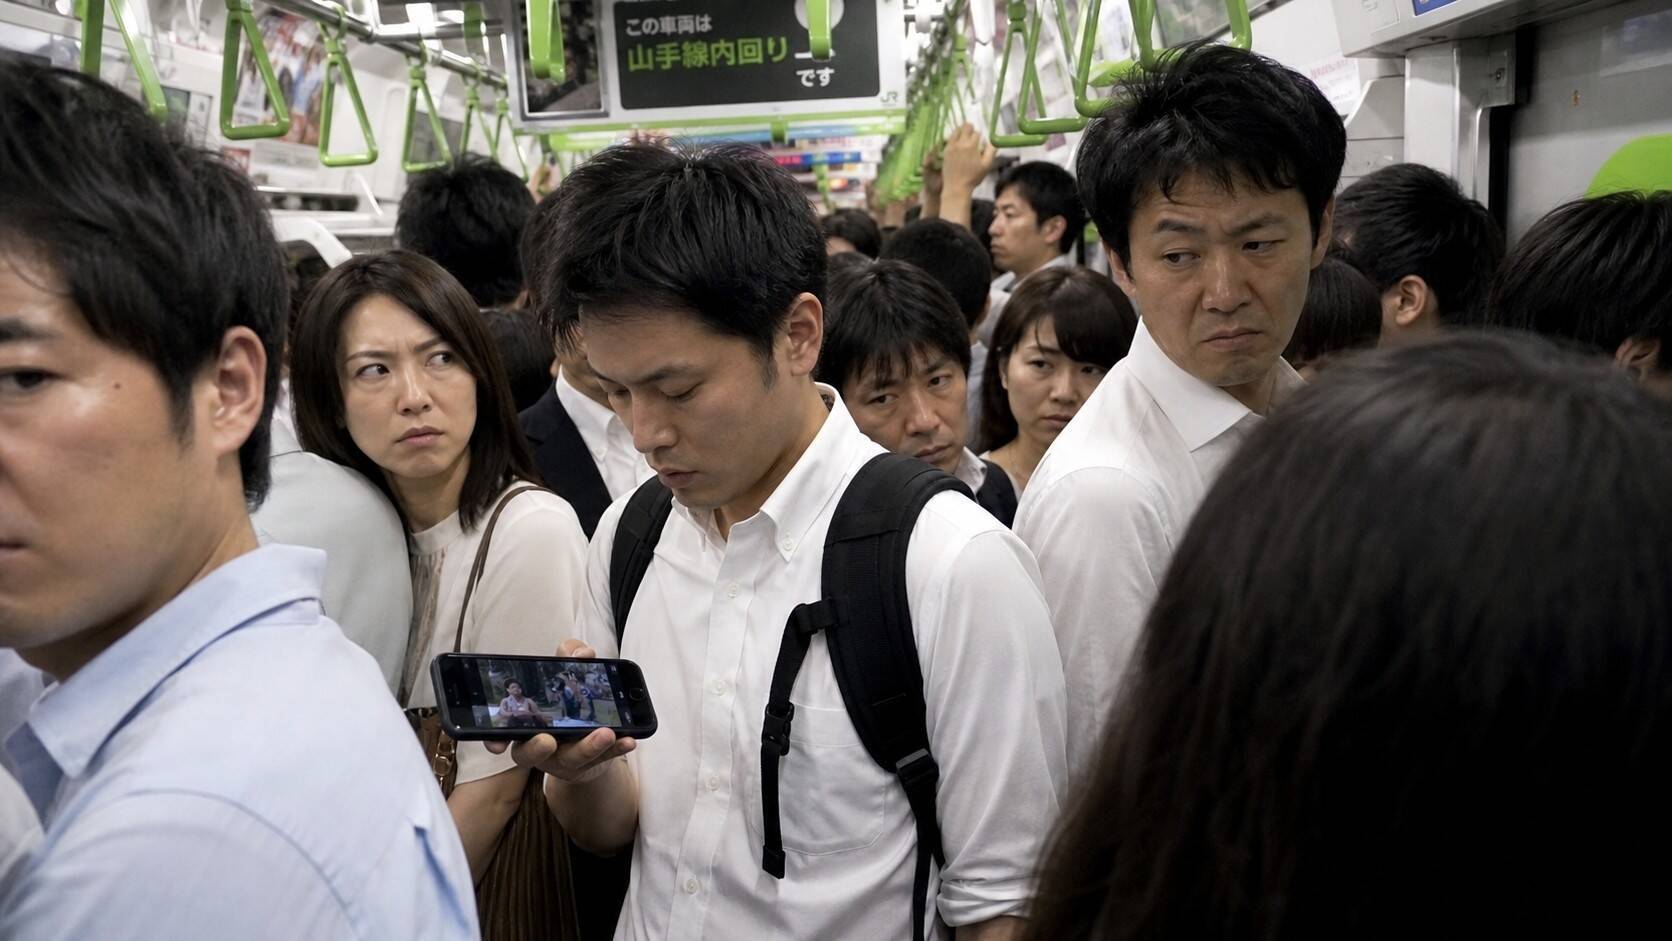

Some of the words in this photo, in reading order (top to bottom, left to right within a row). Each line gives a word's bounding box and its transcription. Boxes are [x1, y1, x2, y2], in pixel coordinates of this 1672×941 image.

[625, 14, 712, 36] この車両は
[627, 37, 787, 72] 山手線内回り
[796, 67, 835, 87] です
[881, 91, 898, 103] JR
